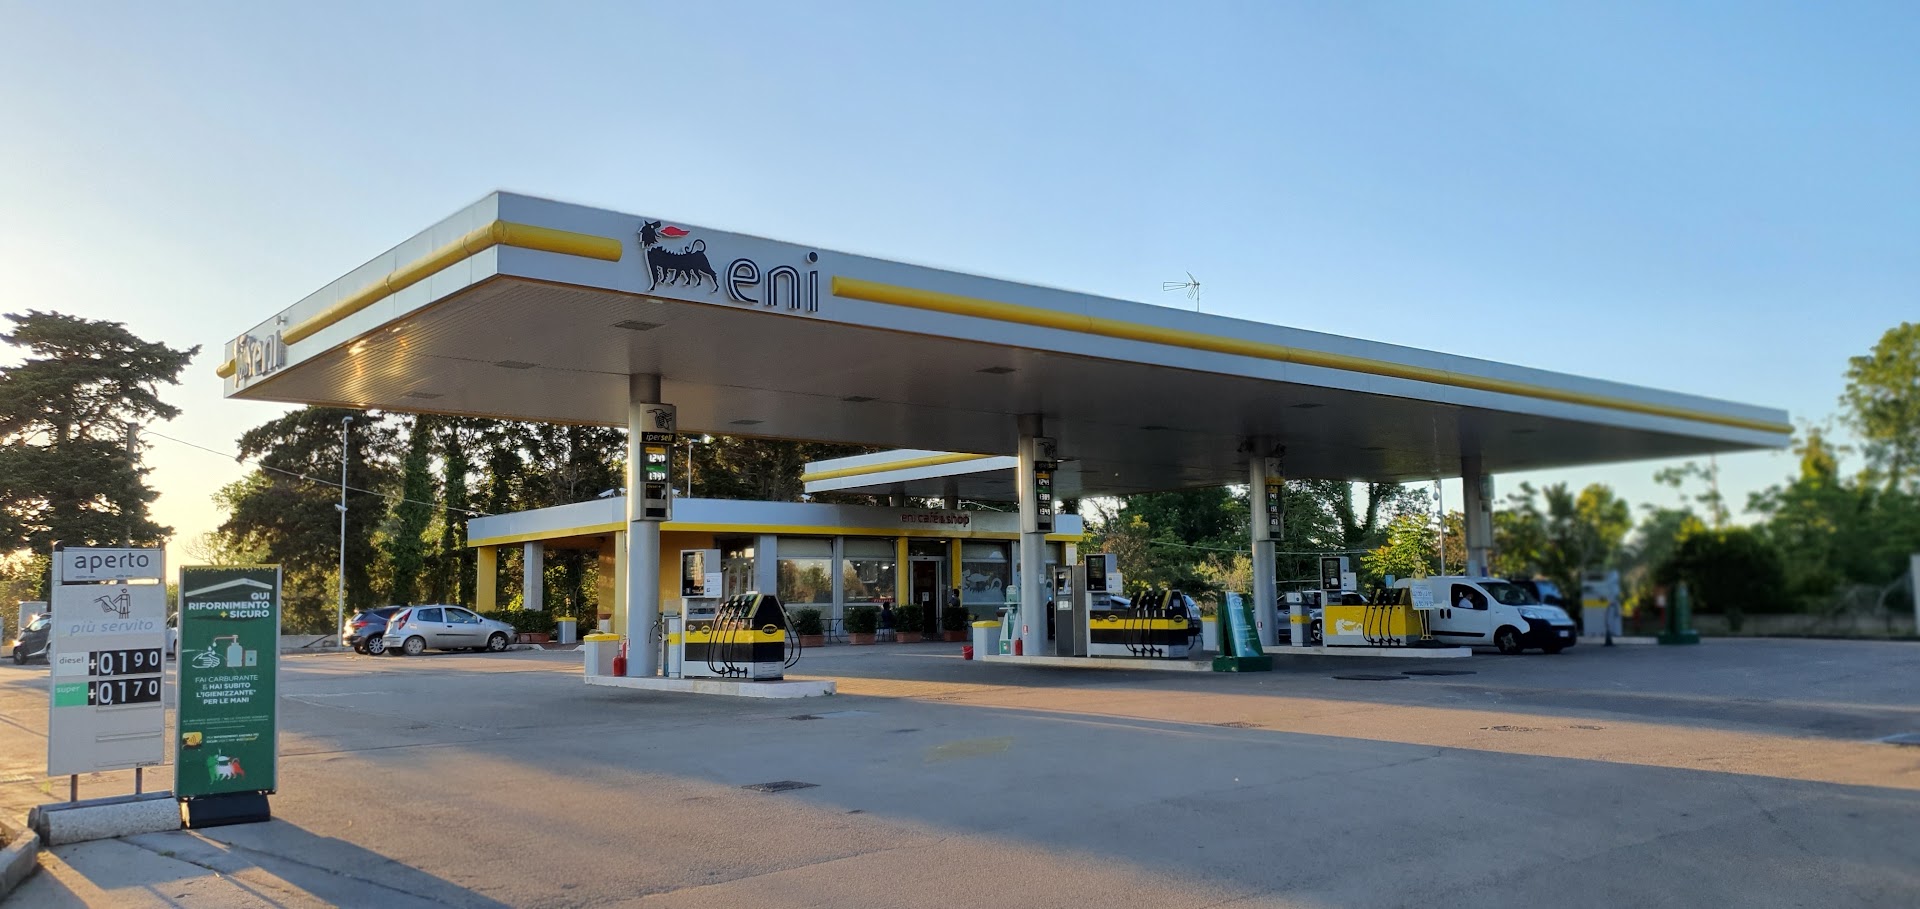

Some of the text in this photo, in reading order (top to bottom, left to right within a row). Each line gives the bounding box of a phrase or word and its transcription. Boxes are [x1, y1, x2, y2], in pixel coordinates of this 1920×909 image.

[725, 251, 818, 312] eni
[74, 552, 150, 574] aperto
[250, 592, 270, 600] QUI
[188, 601, 270, 610] RIFORNIMENTO
[229, 610, 270, 618] SICURO
[70, 619, 153, 636] più servito
[59, 656, 84, 665] diesel
[56, 685, 80, 694] super
